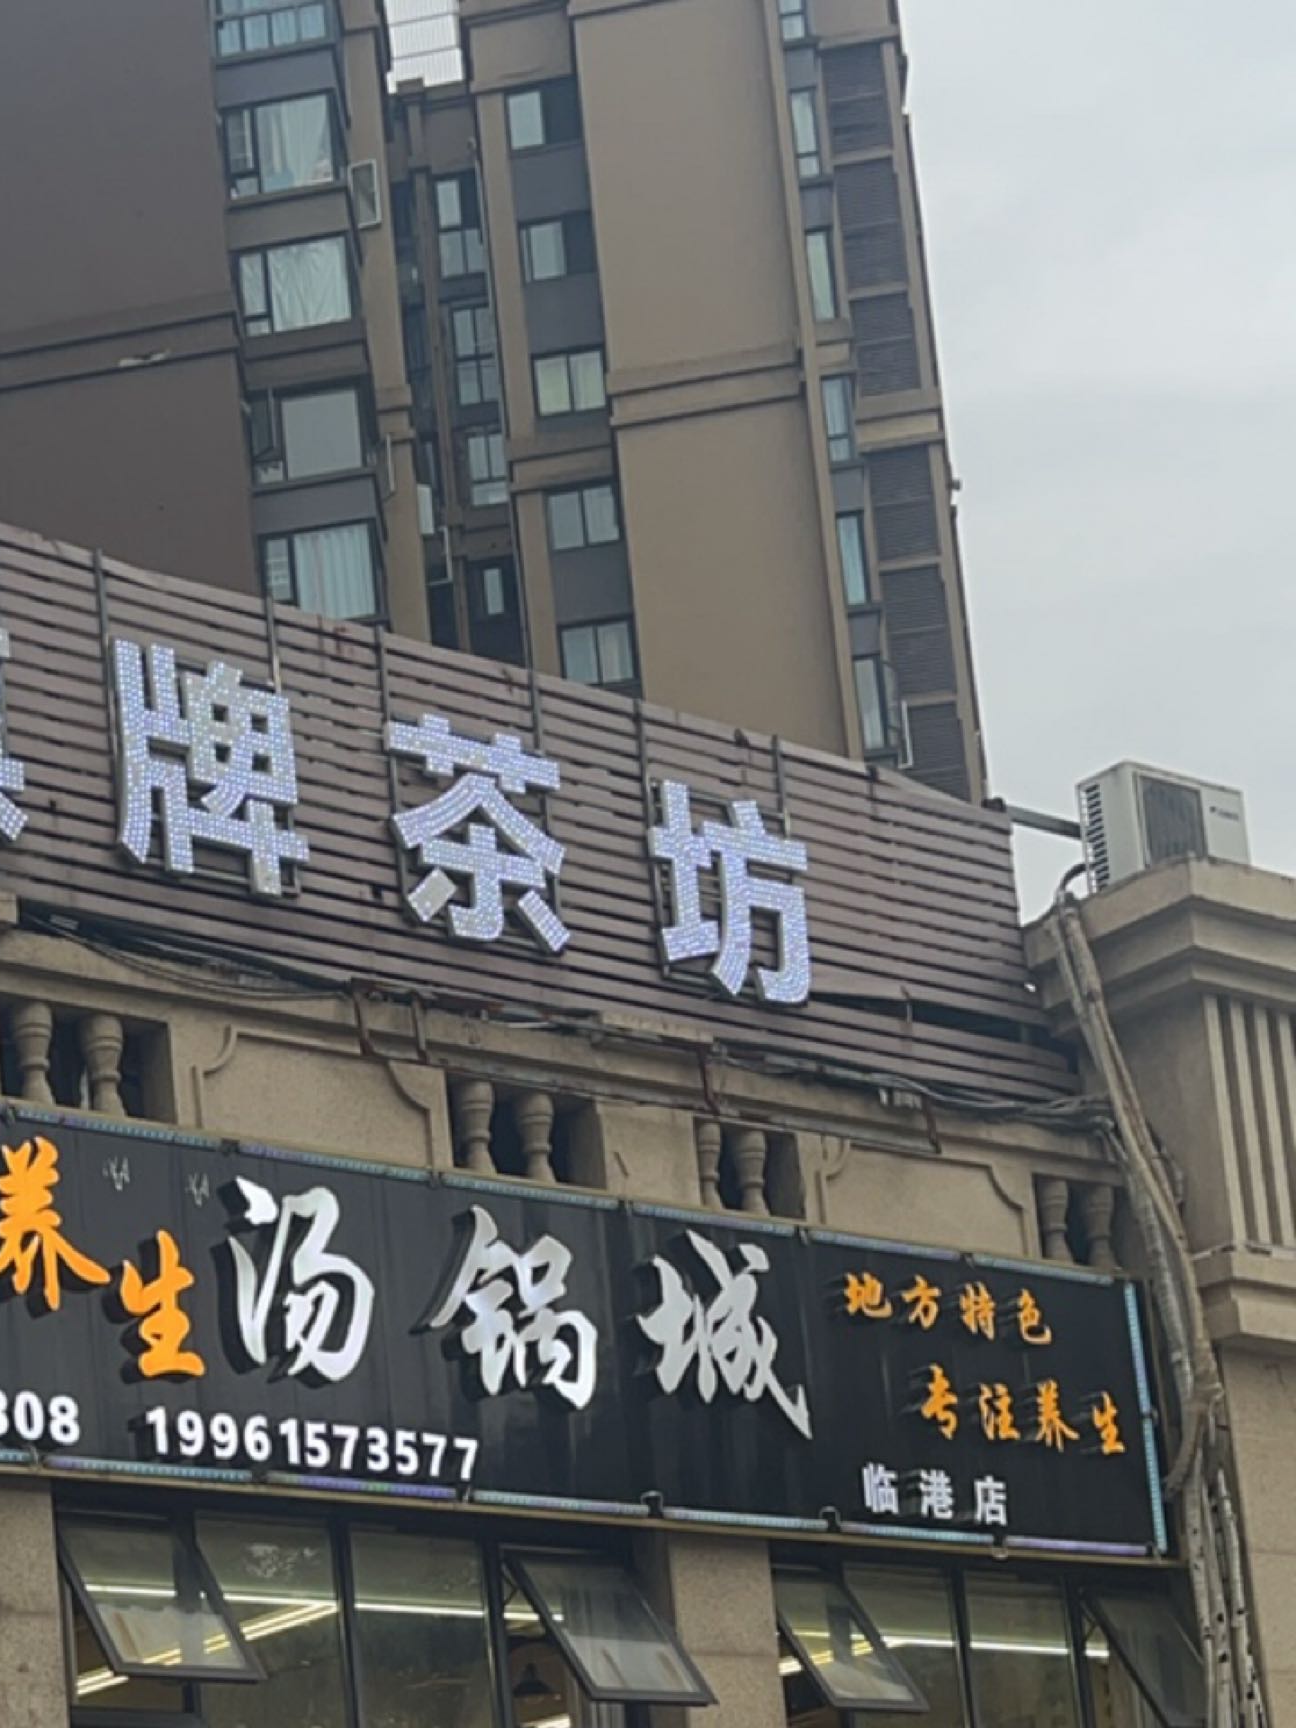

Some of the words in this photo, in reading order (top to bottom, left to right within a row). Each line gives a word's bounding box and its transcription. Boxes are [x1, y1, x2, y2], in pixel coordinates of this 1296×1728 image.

[842, 1272, 1053, 1345] 地方特色
[146, 1405, 478, 1482] 19961573577
[922, 1365, 1126, 1455] 专注养生
[862, 1462, 1008, 1527] 临港店
